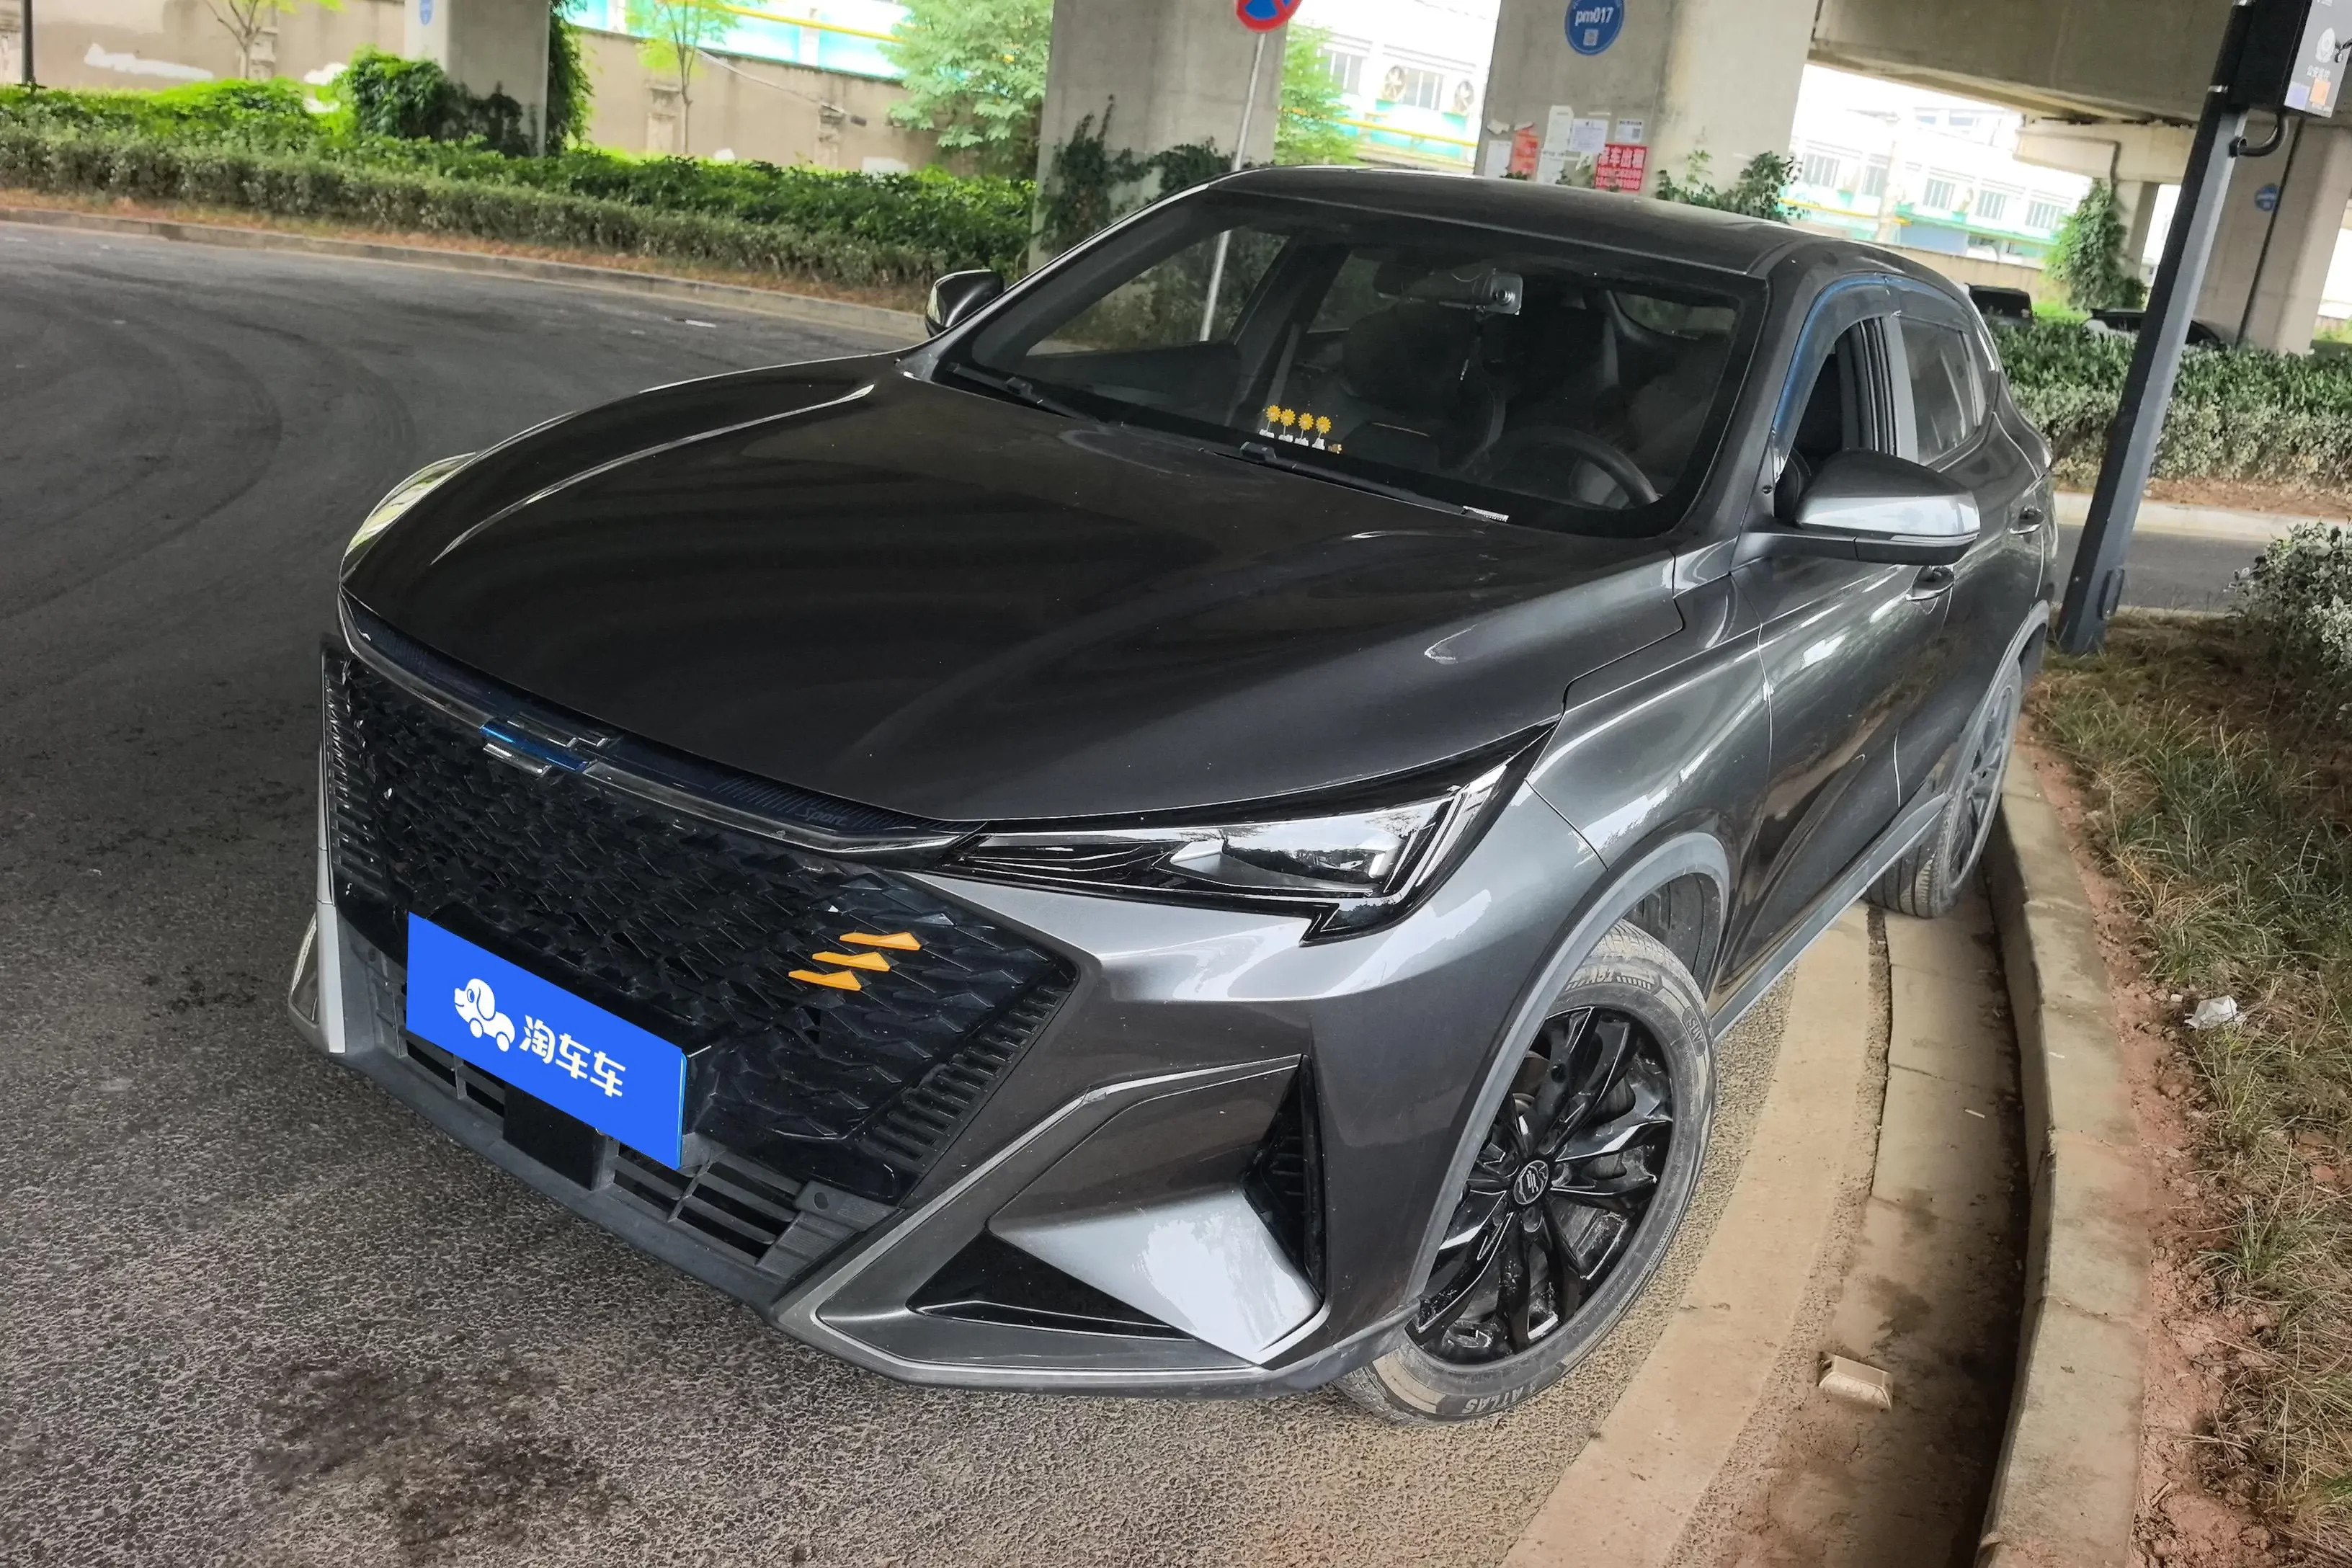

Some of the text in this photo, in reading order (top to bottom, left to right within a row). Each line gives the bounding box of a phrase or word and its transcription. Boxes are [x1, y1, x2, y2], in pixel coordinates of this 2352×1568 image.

[1574, 6, 1614, 27] pm017
[795, 807, 848, 827] Sport
[1687, 1017, 1703, 1043] SUV
[1461, 1386, 1524, 1414] ATLAS
